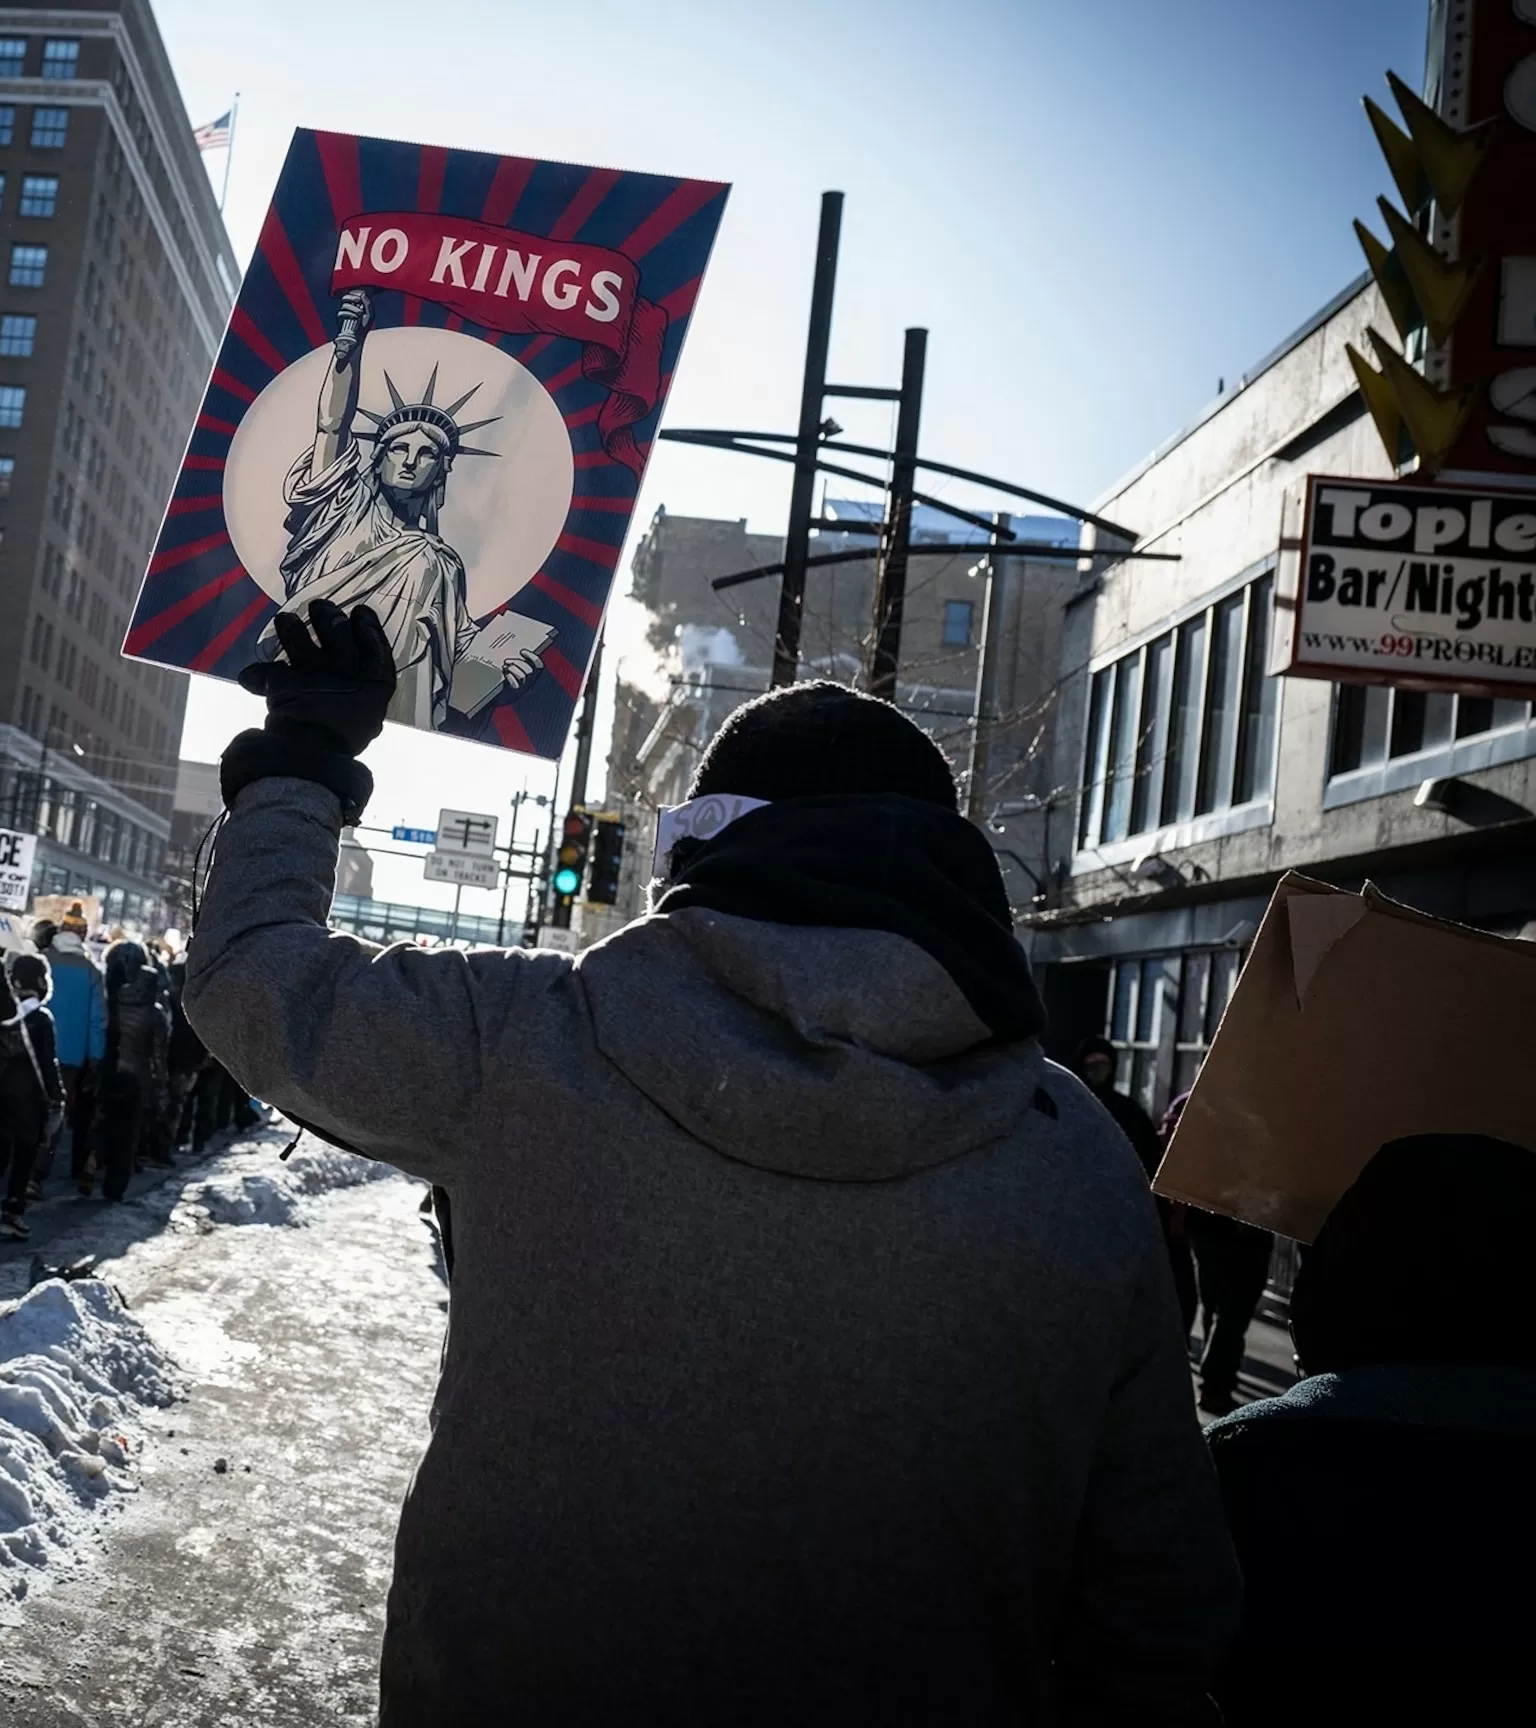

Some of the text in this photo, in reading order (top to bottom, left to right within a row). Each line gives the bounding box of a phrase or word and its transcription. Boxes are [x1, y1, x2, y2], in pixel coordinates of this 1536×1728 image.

[333, 226, 623, 322] NO KINGS
[1319, 488, 1536, 553] Tople
[1307, 553, 1536, 631] Bar/Night
[1303, 632, 1536, 669] www.99PROBLE
[7, 873, 27, 882] OF
[430, 856, 494, 873] DO NOT TURN
[435, 869, 487, 883] ON TRACKS
